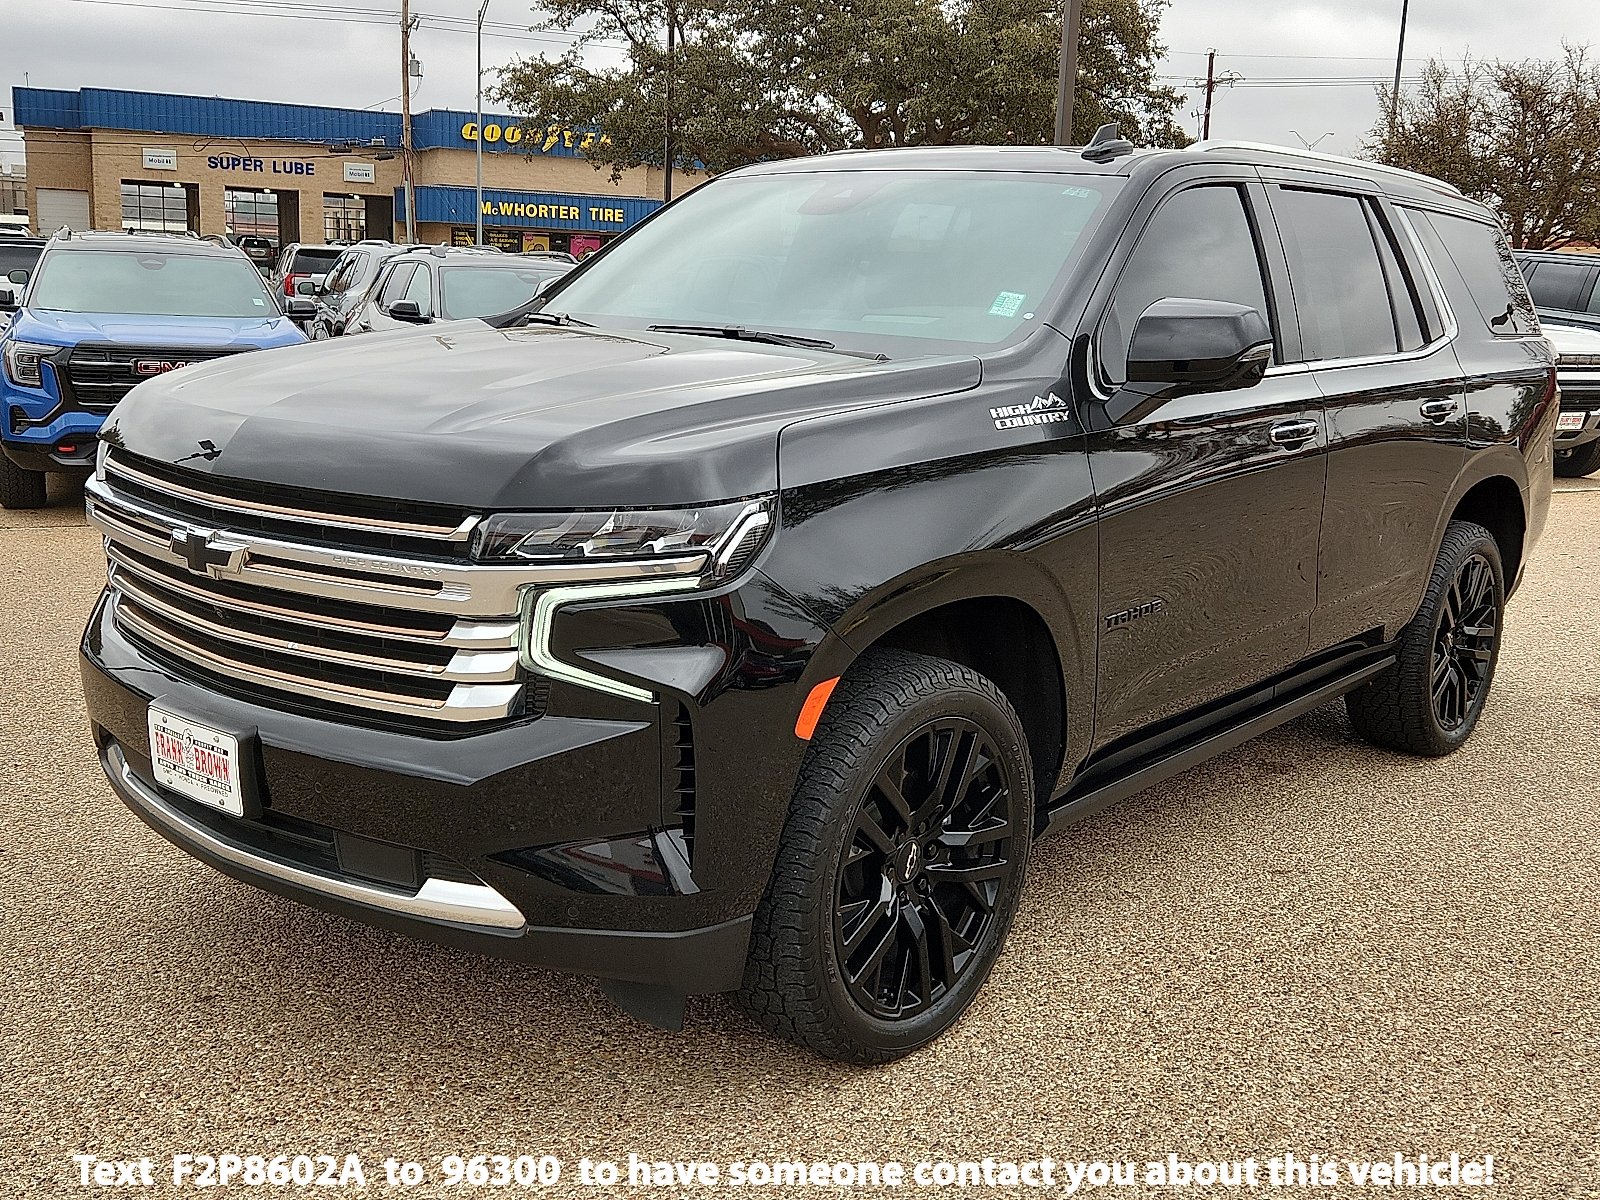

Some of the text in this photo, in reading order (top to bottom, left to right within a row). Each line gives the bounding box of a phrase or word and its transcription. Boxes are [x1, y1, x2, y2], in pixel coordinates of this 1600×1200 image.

[461, 122, 613, 151] GOOYE
[207, 156, 315, 176] SUPER LUBE
[480, 201, 625, 223] McWHORTER TIRE
[137, 361, 199, 375] GM
[989, 404, 1031, 419] HIGH
[994, 410, 1070, 430] COUNTRY
[1104, 599, 1162, 629] TAHOE
[154, 731, 185, 765] FRANK
[194, 746, 231, 784] BROWN
